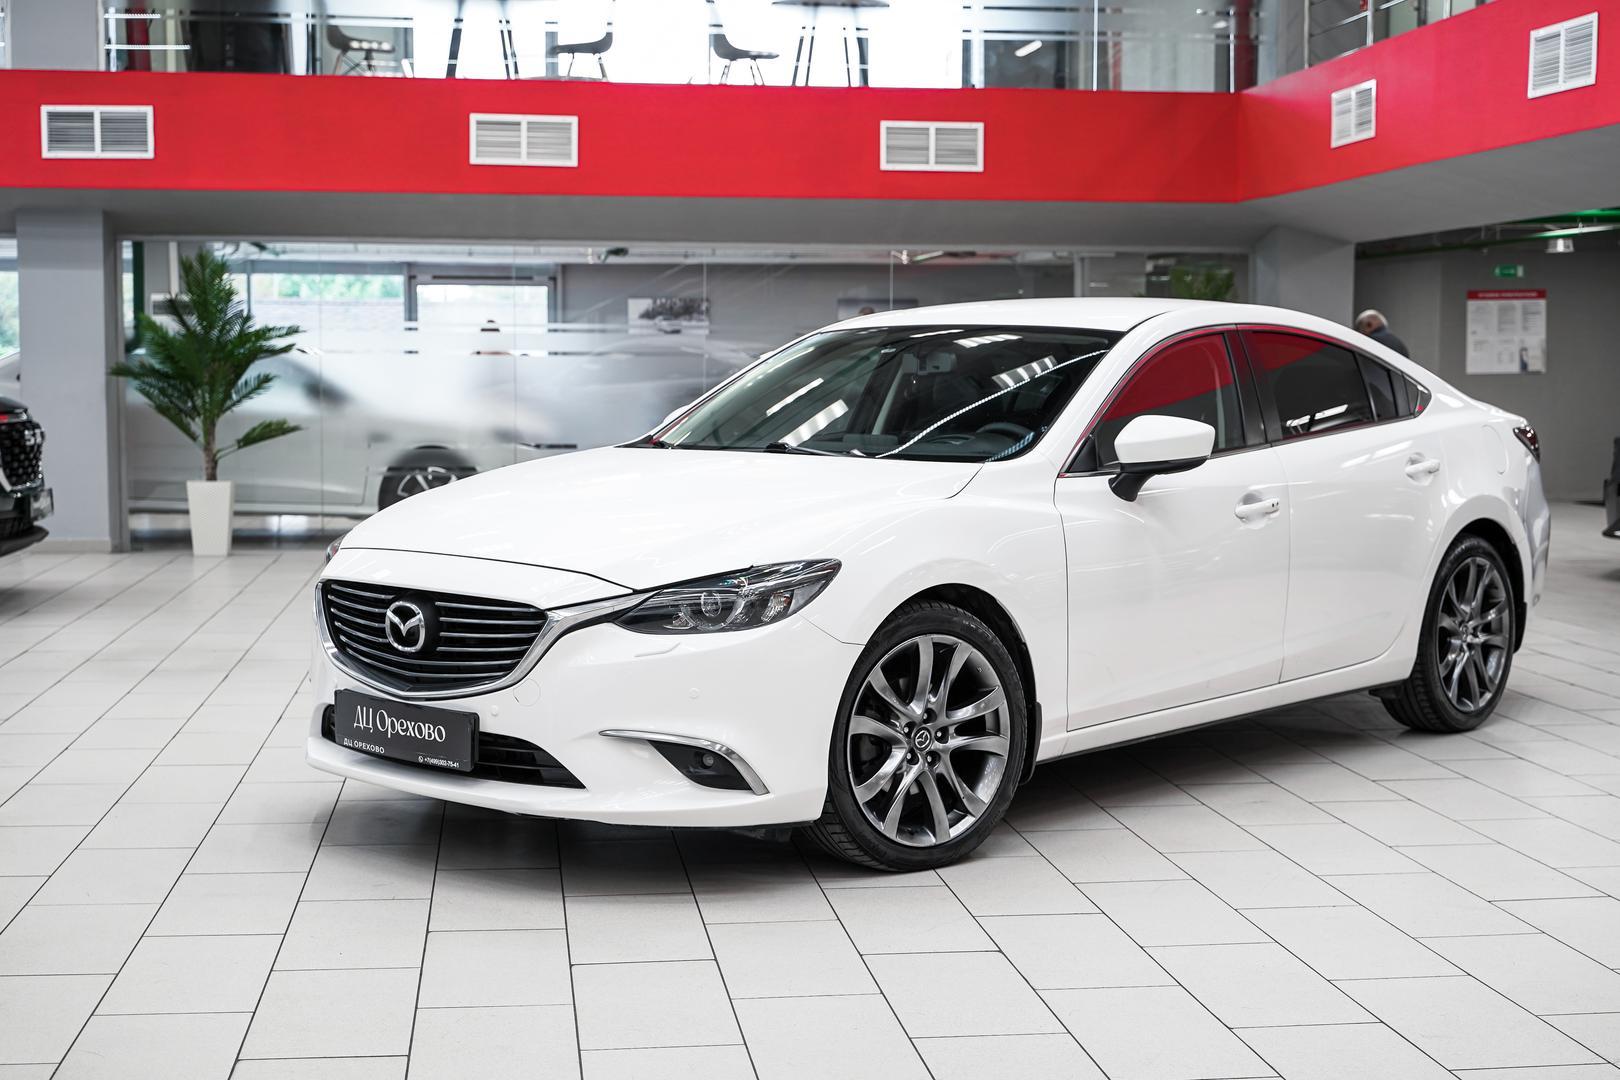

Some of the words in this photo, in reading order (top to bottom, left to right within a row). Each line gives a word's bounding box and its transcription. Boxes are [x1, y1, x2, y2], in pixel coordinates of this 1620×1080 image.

[353, 705, 374, 733] ДЦ
[376, 709, 446, 743] Орехово
[343, 737, 353, 747] ДЦ
[353, 740, 385, 754] ОРЕХОВО
